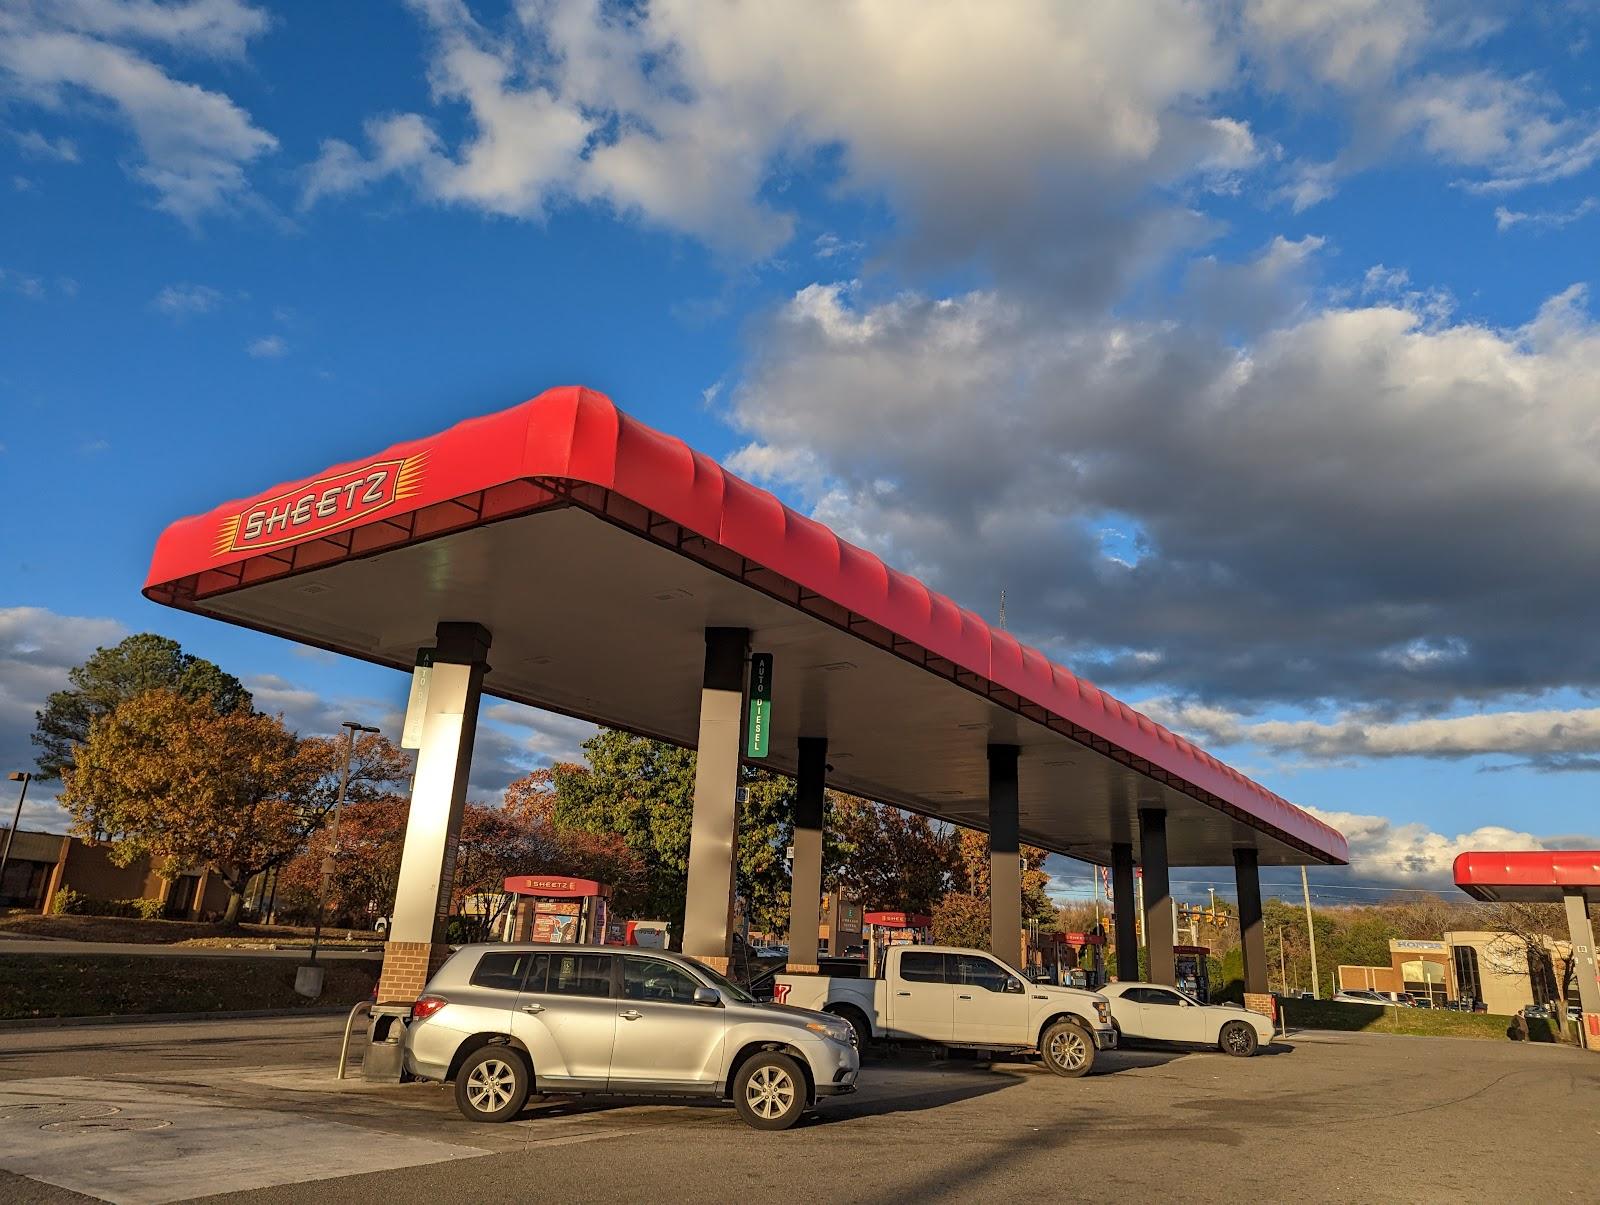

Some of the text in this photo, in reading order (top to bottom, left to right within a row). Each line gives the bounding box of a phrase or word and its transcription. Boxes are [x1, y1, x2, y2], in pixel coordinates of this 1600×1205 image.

[243, 470, 388, 540] SHEETZ
[754, 699, 763, 751] DIESEL
[533, 880, 568, 889] SHEETZ
